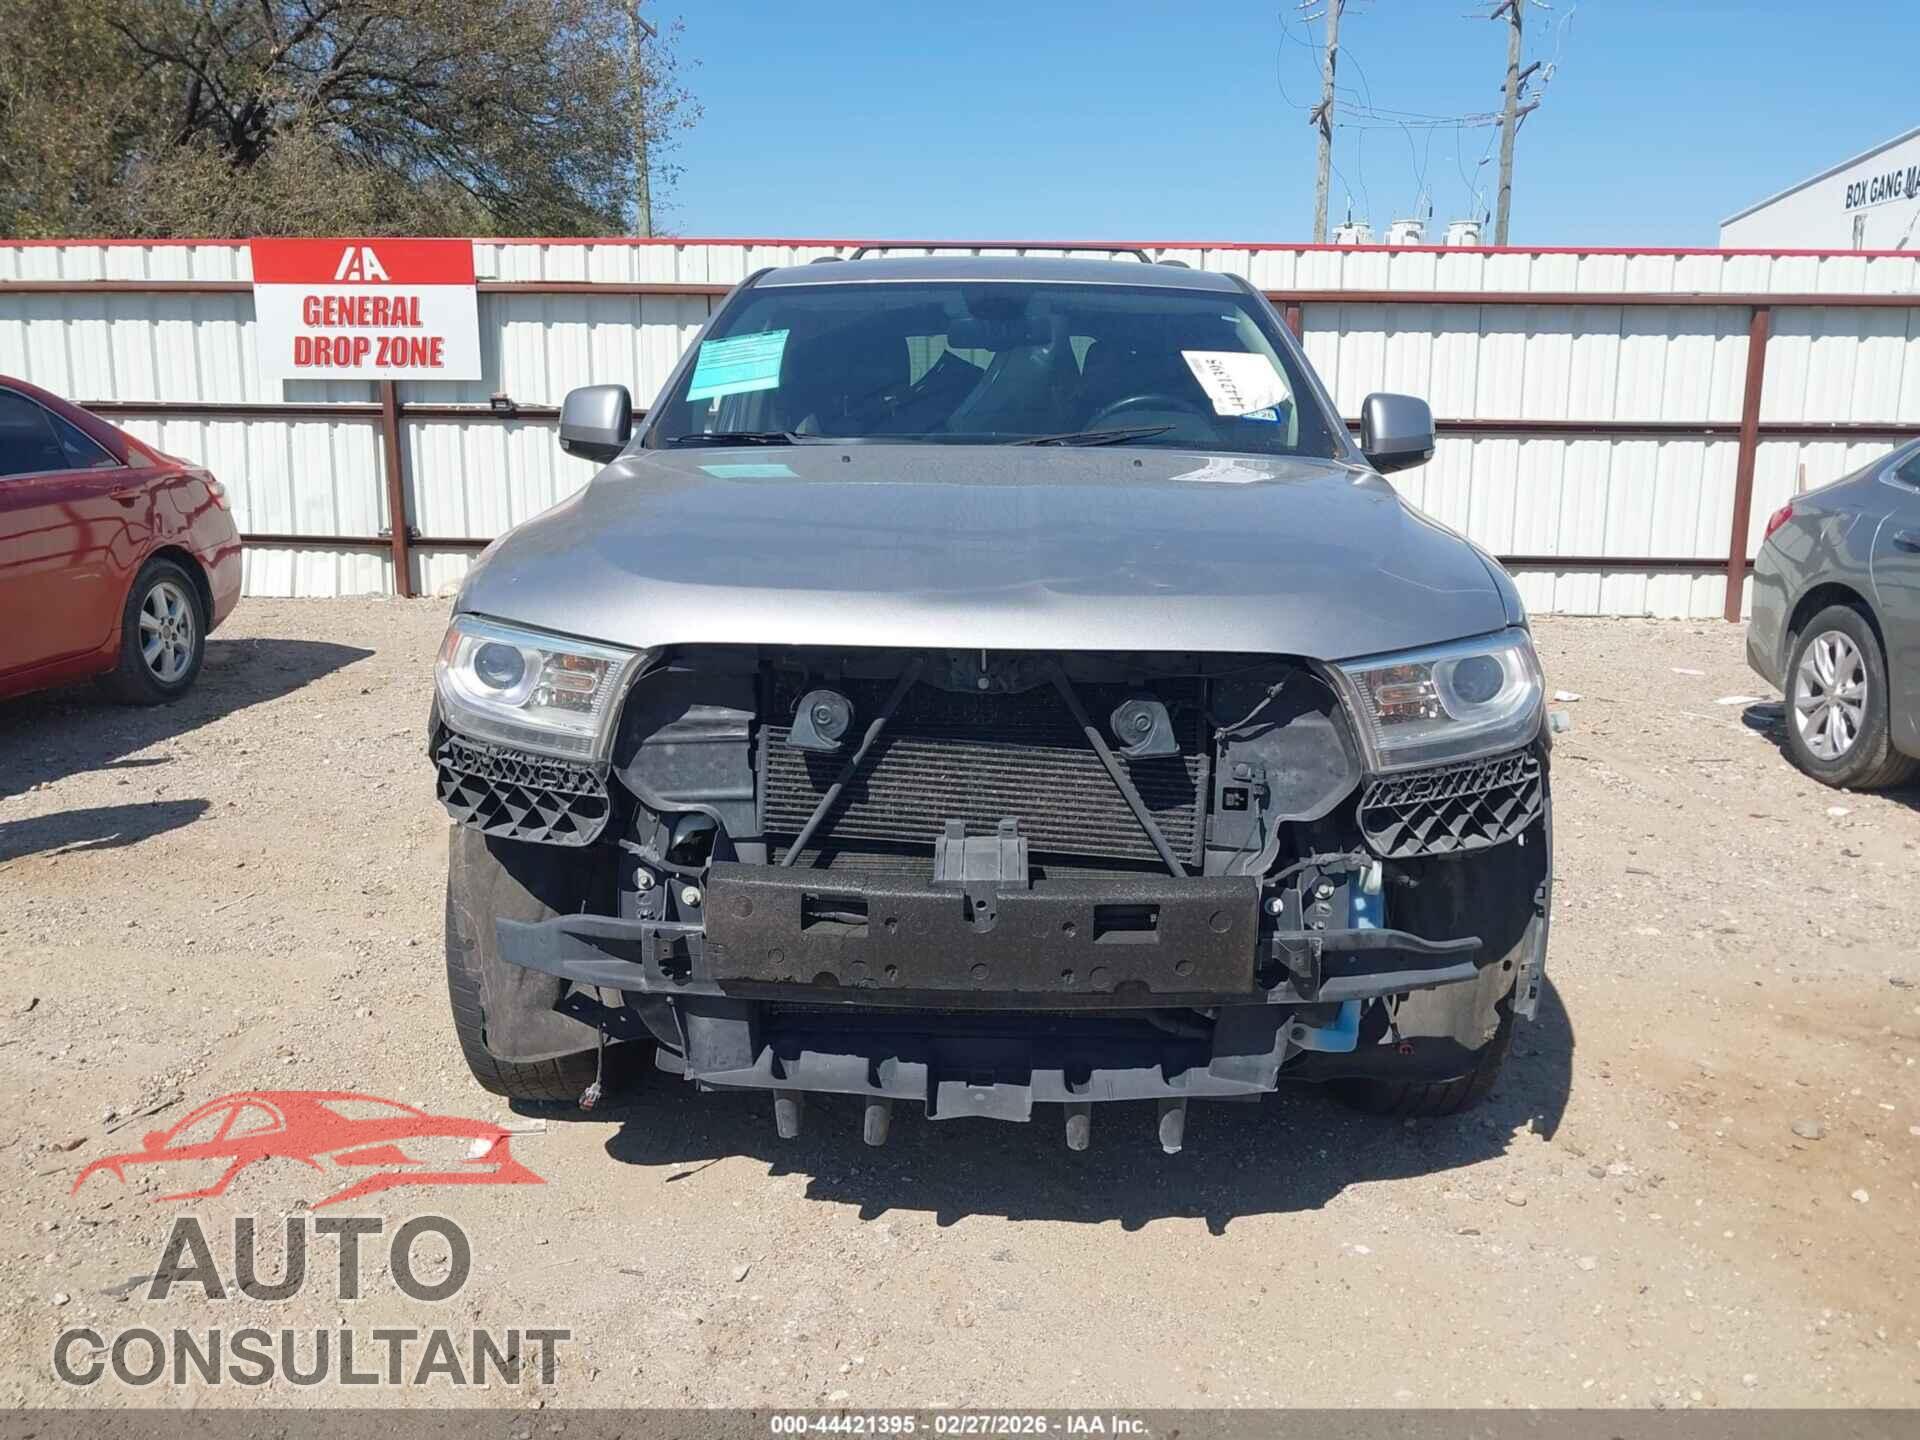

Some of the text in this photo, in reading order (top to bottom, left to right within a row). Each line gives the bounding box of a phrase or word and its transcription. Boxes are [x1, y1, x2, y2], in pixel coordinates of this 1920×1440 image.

[1845, 179, 1868, 209] BOX
[1870, 170, 1902, 203] GANG
[303, 295, 423, 327] GENERAL
[294, 336, 444, 368] DROP ZONE
